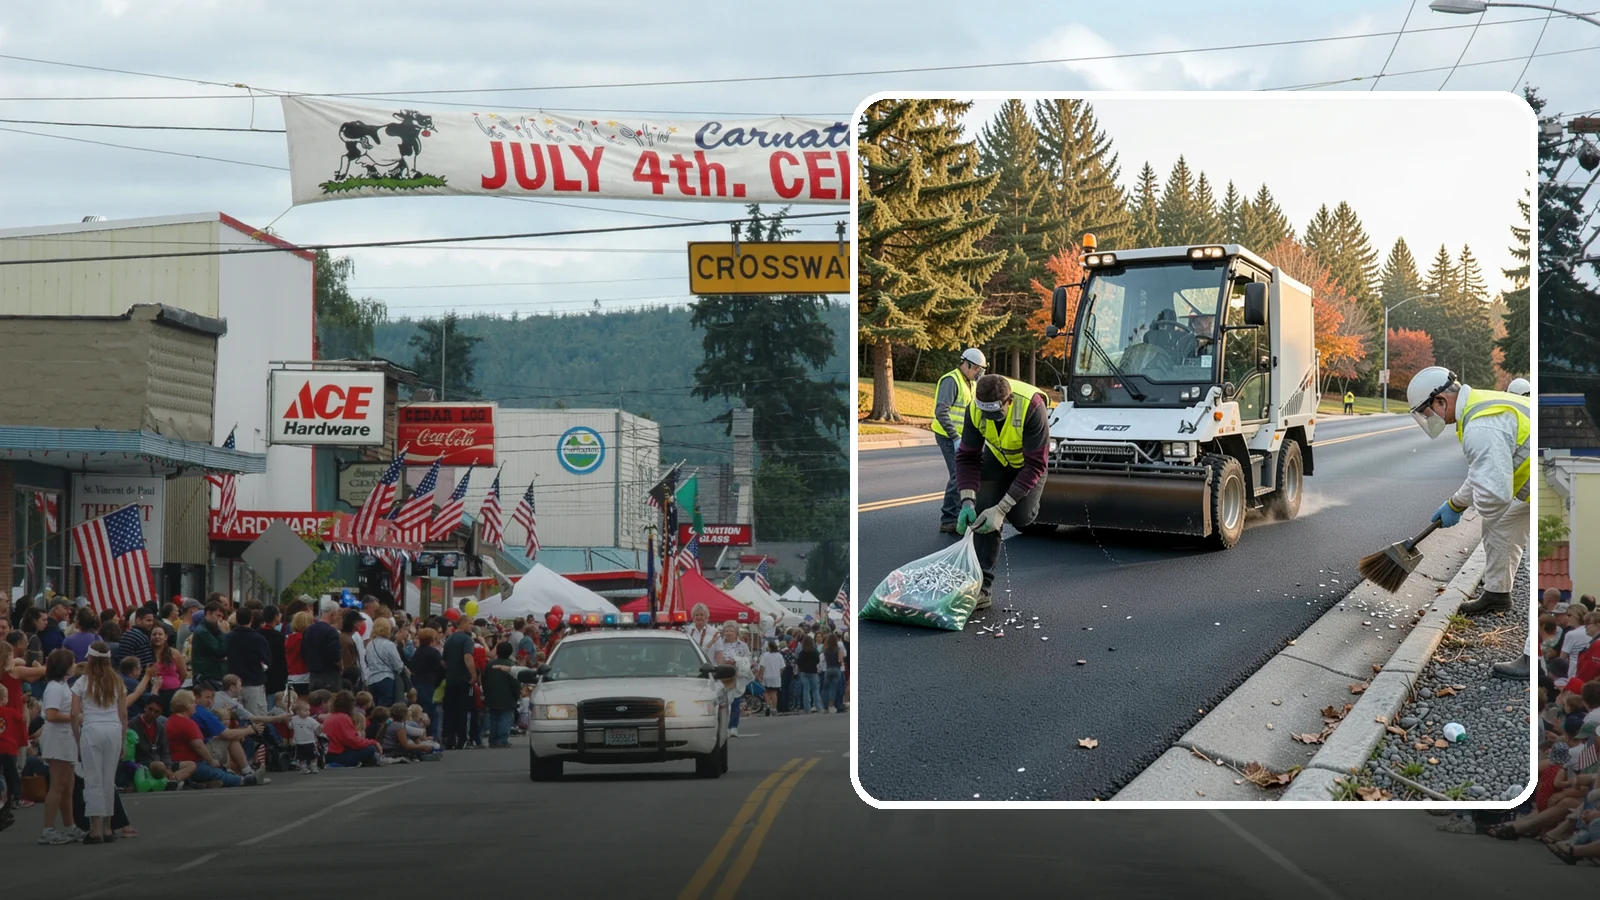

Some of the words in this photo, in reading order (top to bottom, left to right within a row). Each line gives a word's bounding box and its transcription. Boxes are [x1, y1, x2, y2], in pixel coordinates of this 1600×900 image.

[695, 121, 850, 149] Carnat
[481, 141, 604, 192] JULY
[632, 150, 746, 197] 4th.
[697, 254, 850, 280] CROSSWA
[283, 380, 373, 420] ACE
[405, 409, 452, 422] CEDAR
[461, 409, 485, 422] LOG
[283, 421, 370, 436] Hardware
[416, 428, 476, 447] Coca-Cola
[353, 467, 387, 481] Simpl
[83, 484, 94, 494] St.
[96, 485, 124, 495] Vincent
[126, 486, 135, 495] de
[137, 486, 155, 495] Paul
[688, 526, 741, 535] CRNATION
[699, 535, 730, 543] GLASS
